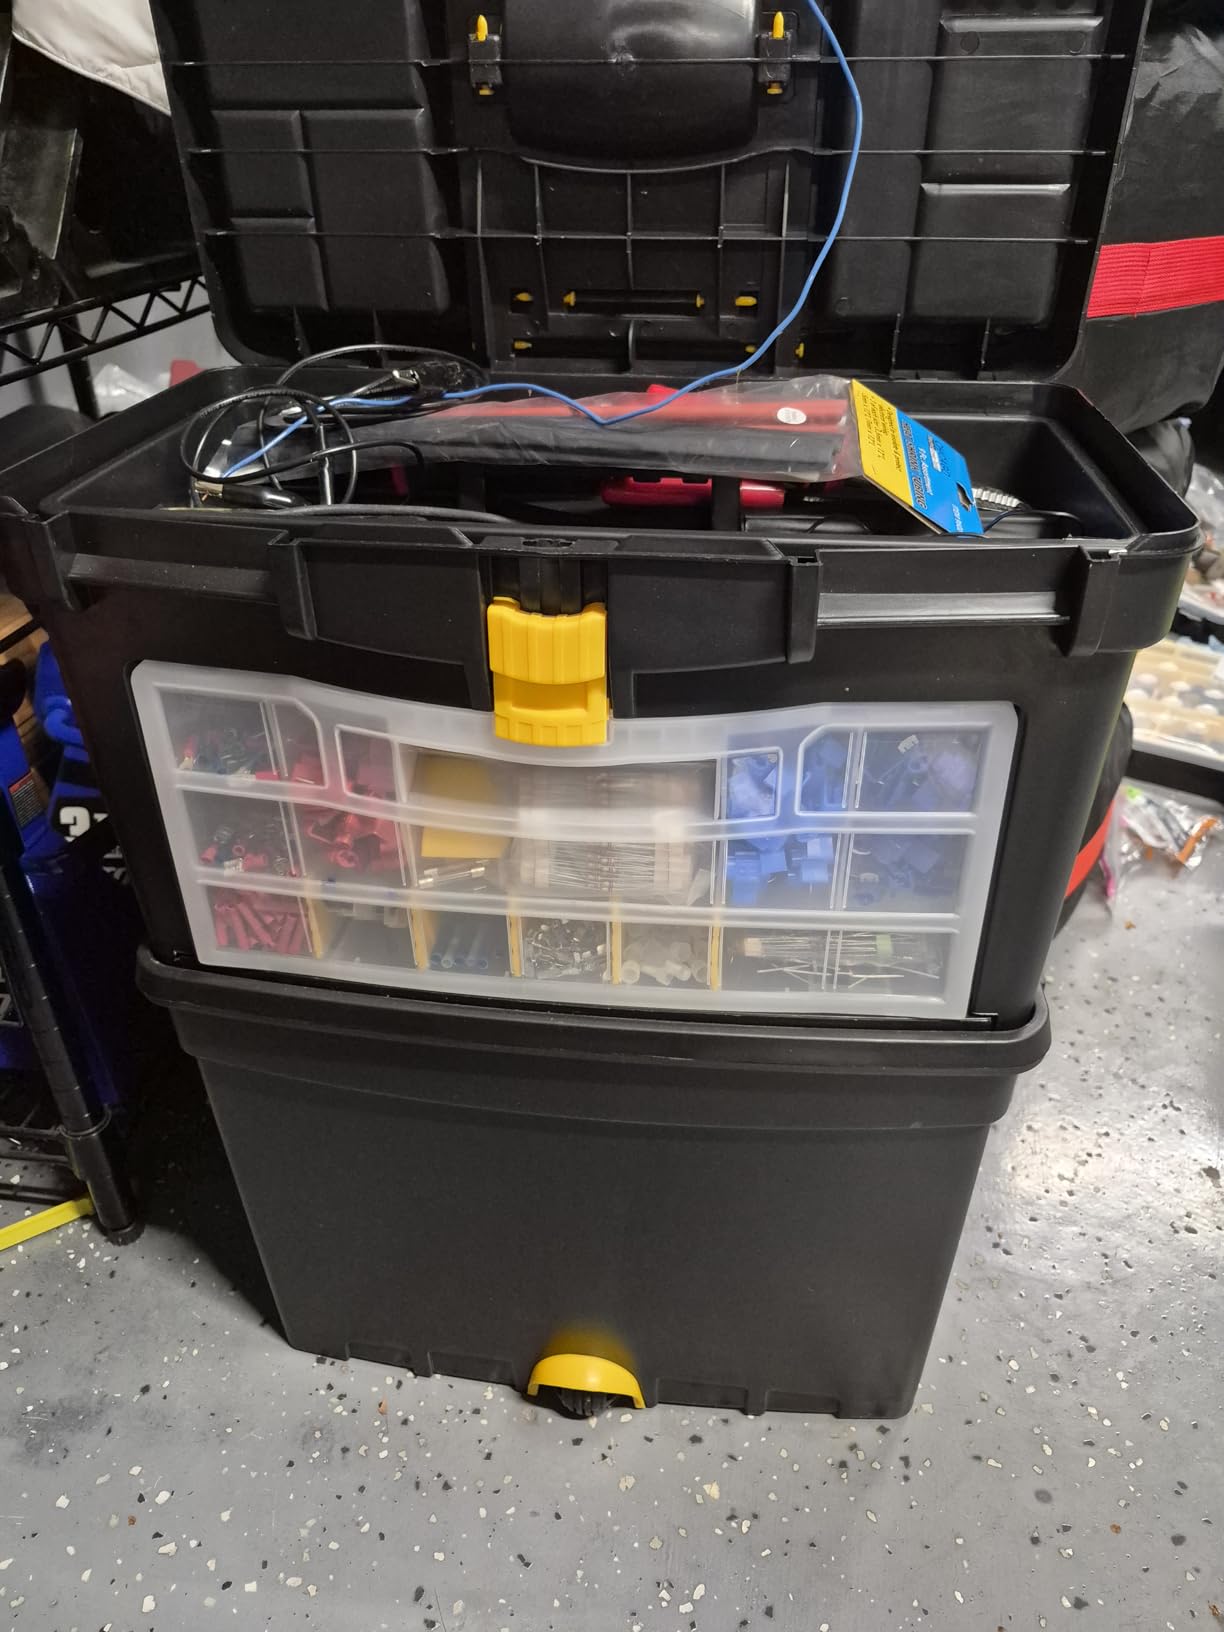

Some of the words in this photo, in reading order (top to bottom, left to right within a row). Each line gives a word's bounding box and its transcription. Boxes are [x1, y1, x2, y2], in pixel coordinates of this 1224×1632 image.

[902, 420, 914, 441] HEAT
[906, 439, 920, 474] SHRINK
[911, 473, 927, 509] TUBING
[922, 460, 934, 496] Assortment
